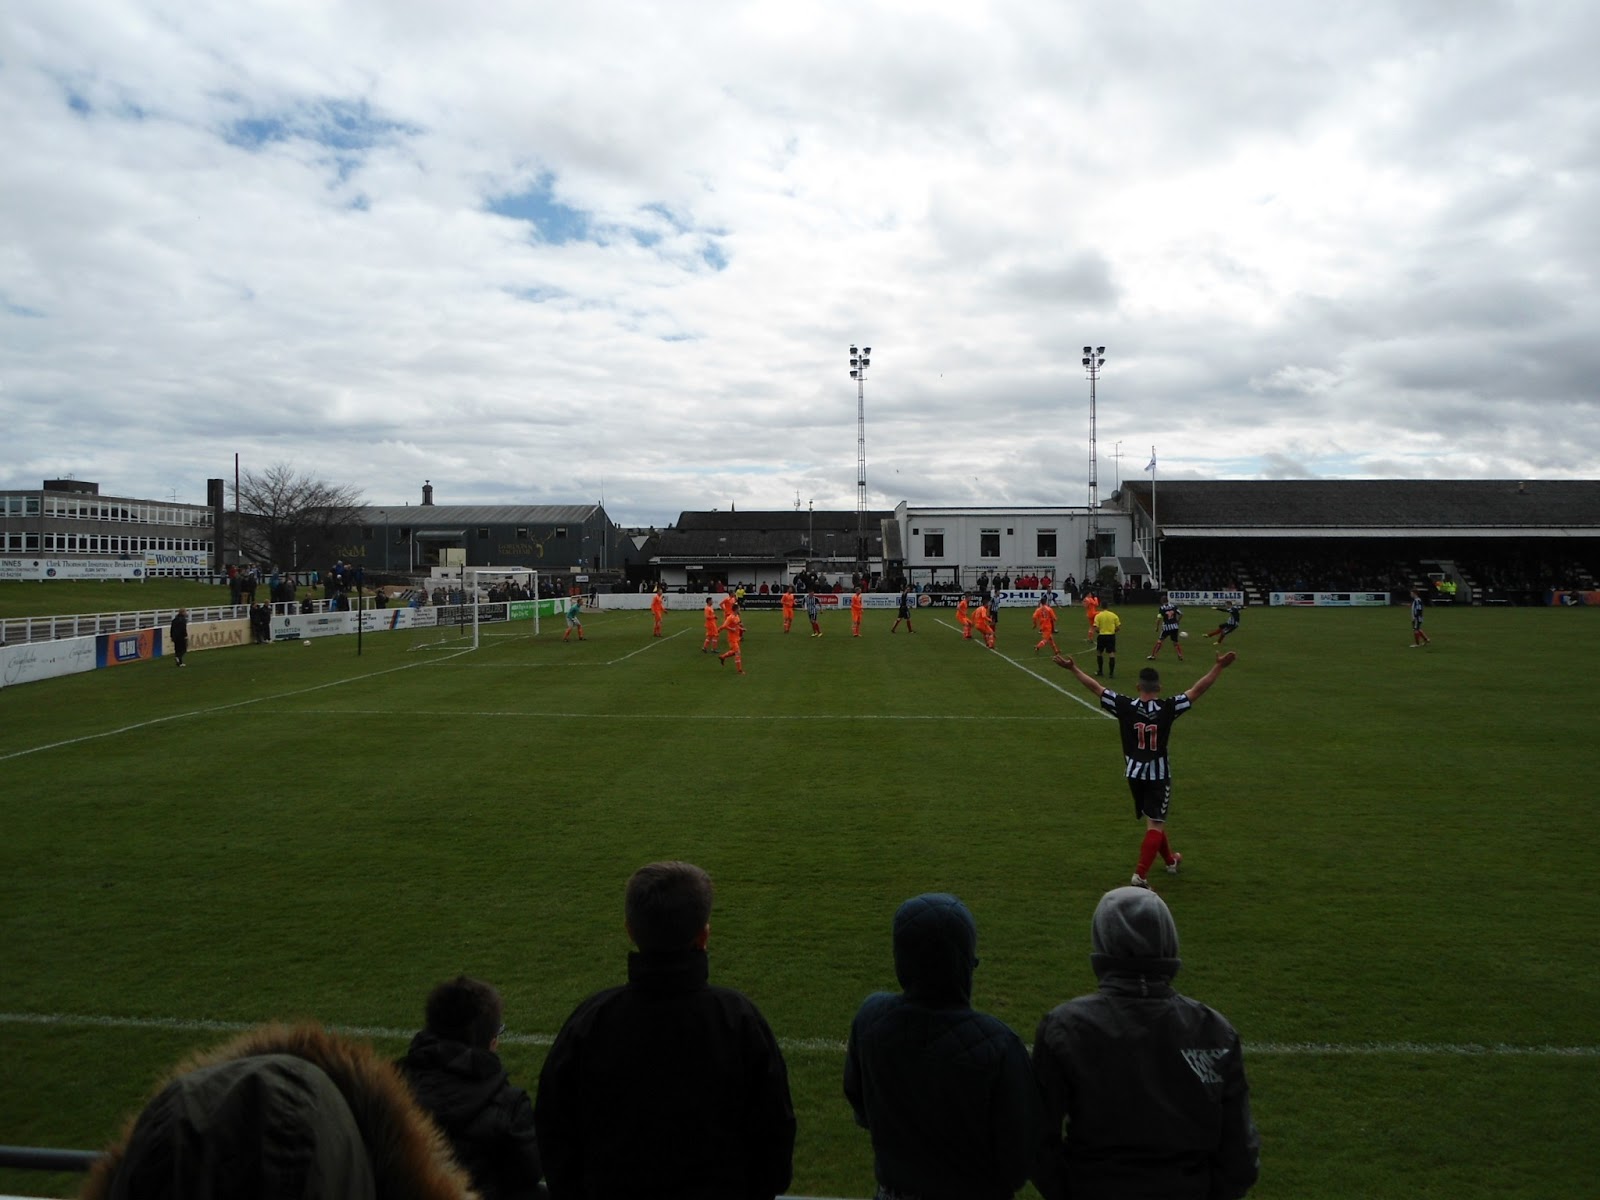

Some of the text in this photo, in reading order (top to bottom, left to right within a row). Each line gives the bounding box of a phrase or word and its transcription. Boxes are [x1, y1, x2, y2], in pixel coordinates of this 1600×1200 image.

[114, 560, 134, 568] Brokers
[134, 560, 143, 568] Ltd
[155, 554, 199, 565] WOODCENTRE
[1134, 722, 1158, 751] 11
